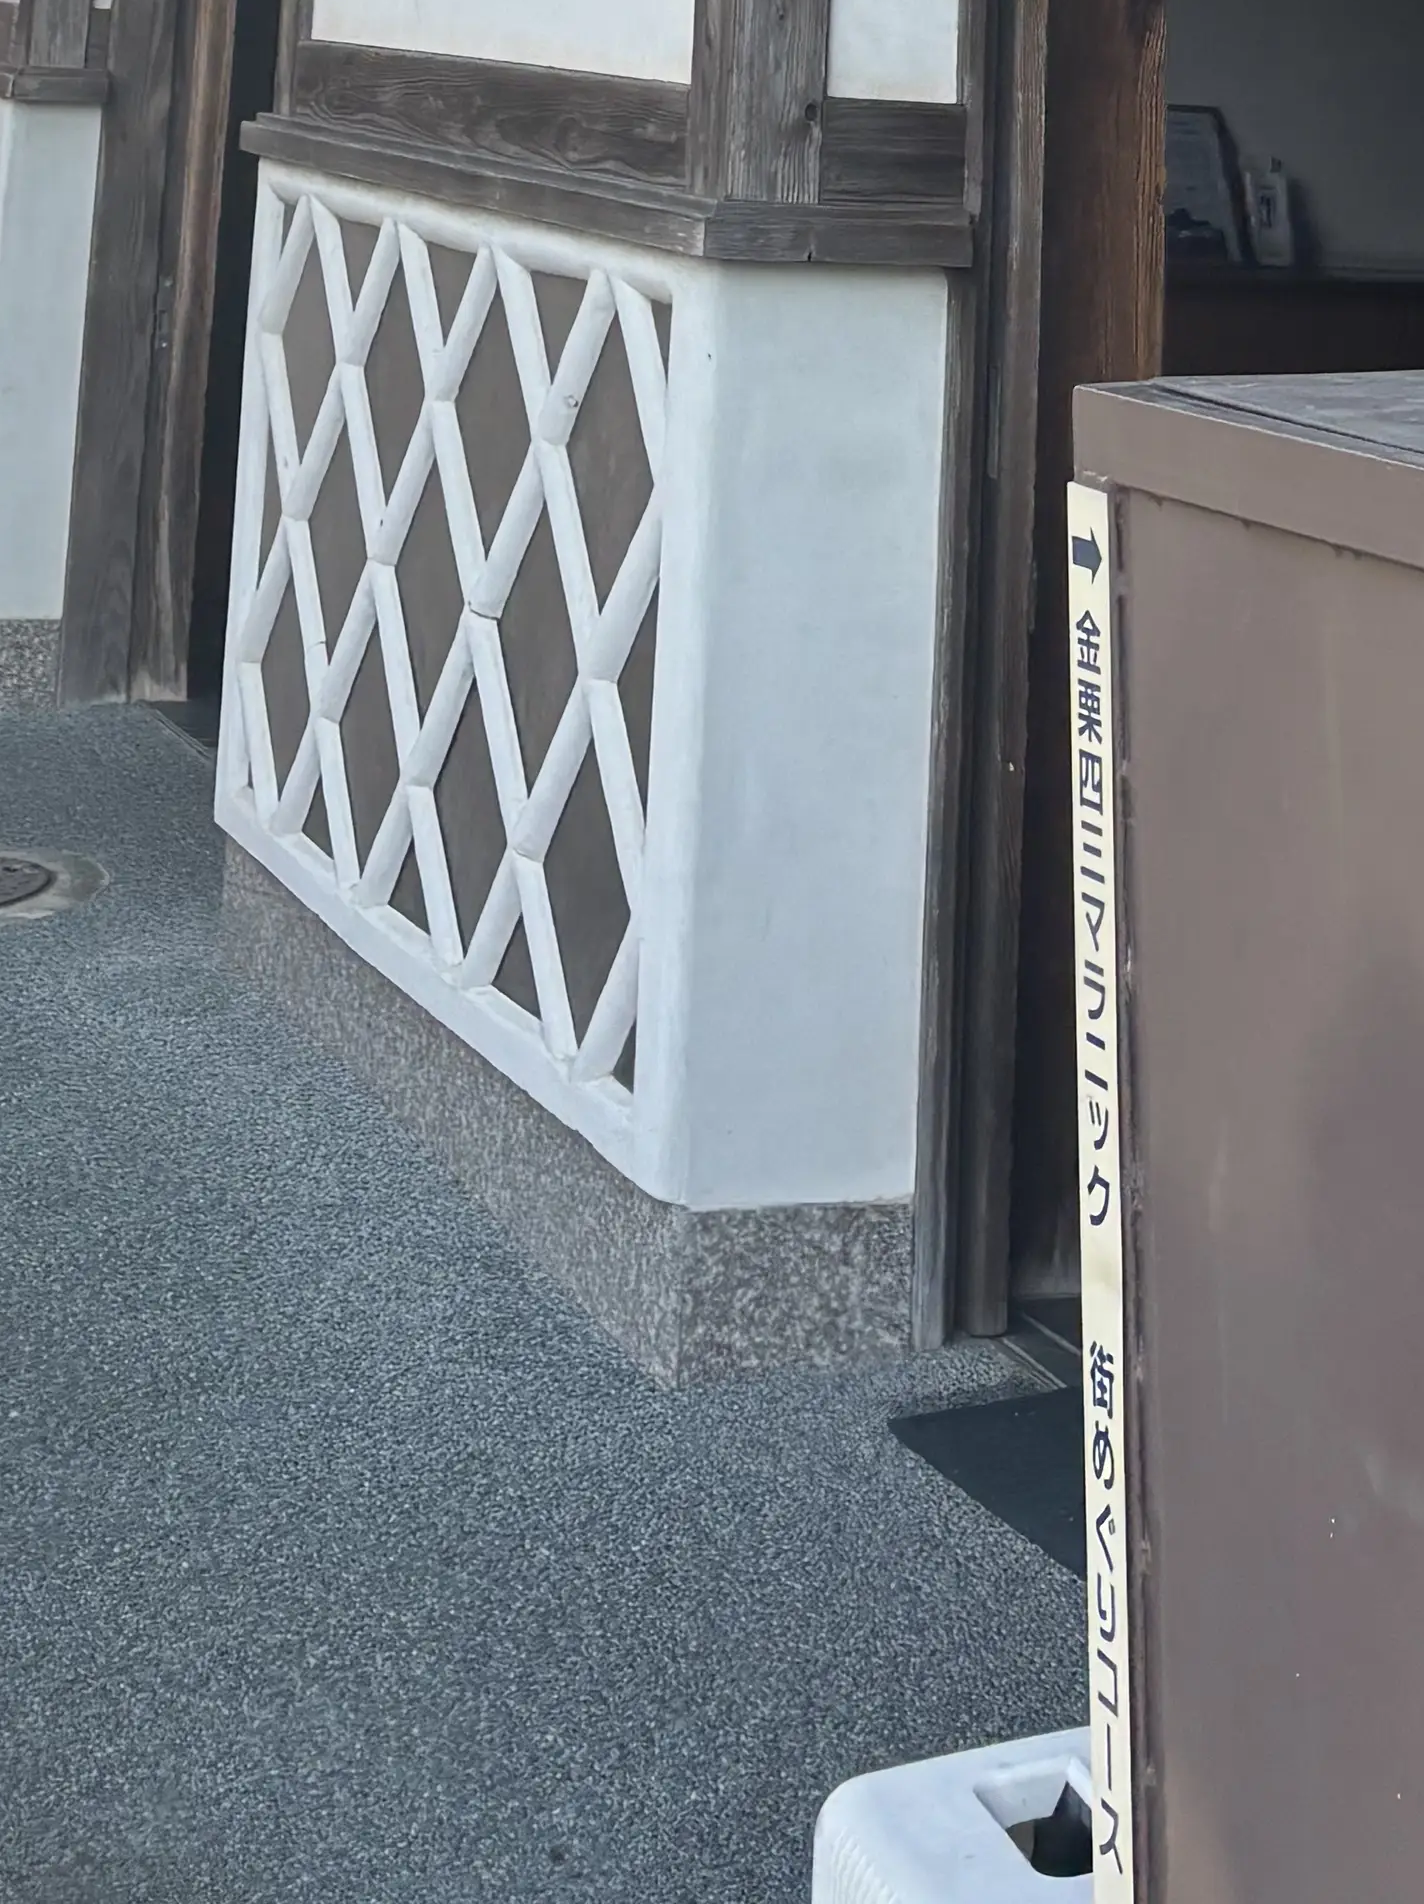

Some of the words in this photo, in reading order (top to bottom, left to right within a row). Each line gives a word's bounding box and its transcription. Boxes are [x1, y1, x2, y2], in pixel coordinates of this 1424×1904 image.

[1089, 1339, 1123, 1875] 街めぐりコース
